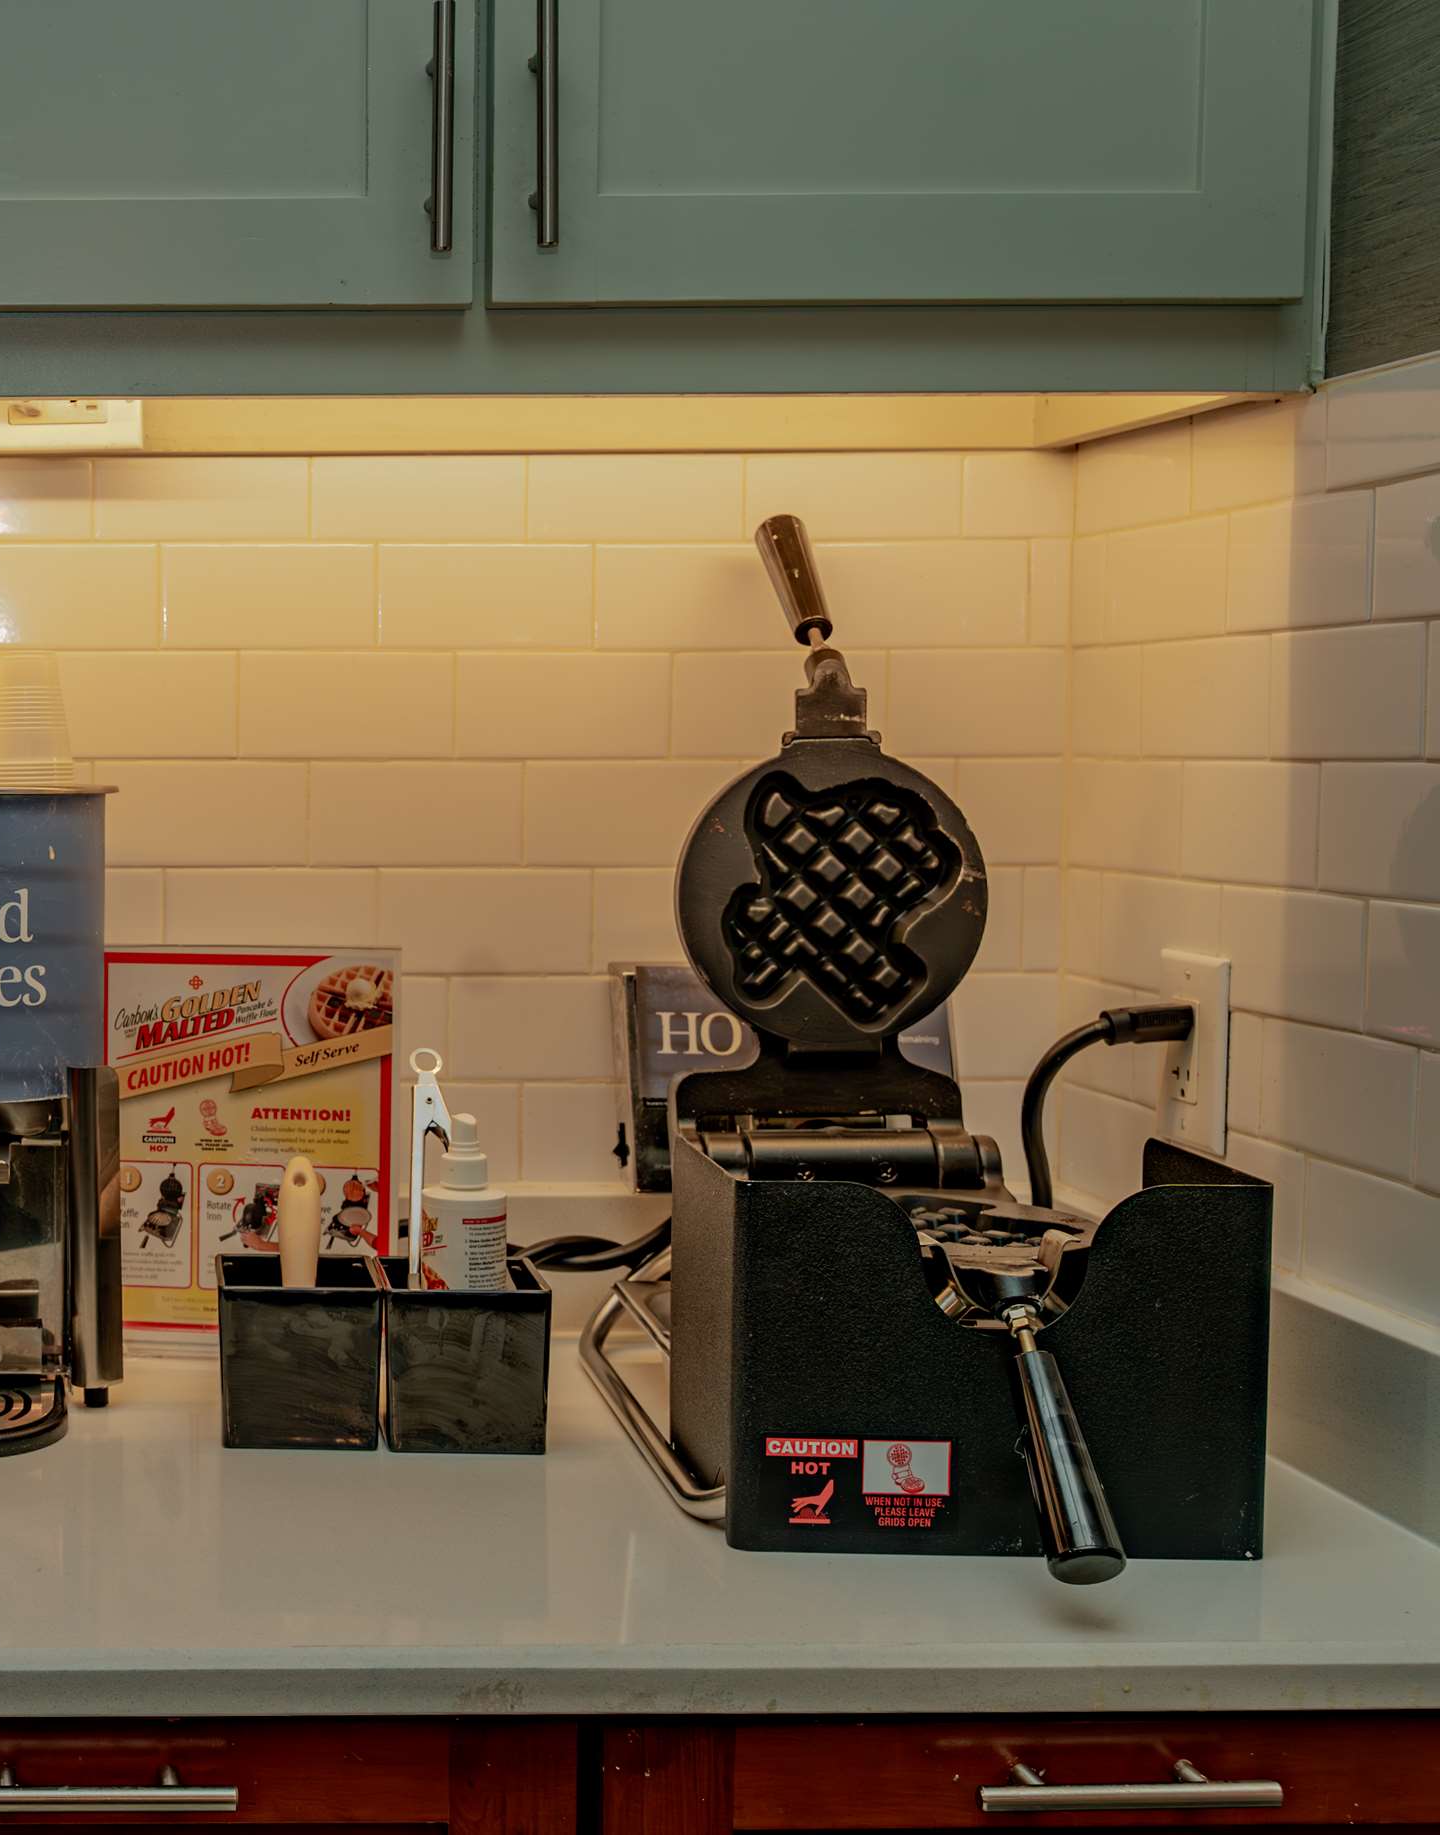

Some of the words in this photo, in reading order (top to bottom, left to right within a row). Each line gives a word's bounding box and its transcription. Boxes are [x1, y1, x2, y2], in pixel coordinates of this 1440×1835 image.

[114, 1003, 159, 1031] Carbon's
[160, 979, 262, 1023] GOLDEN
[236, 1002, 266, 1015] Pancake
[266, 998, 273, 1008] &
[235, 1012, 258, 1024] Waffle
[258, 1008, 278, 1020] Flour
[135, 1007, 236, 1050] MALTED
[655, 1011, 743, 1057] HO
[898, 1034, 940, 1046] emaining
[294, 1048, 321, 1067] Self
[322, 1043, 360, 1060] Serve
[127, 1053, 204, 1090] CAUTION
[208, 1042, 251, 1071] HOT!
[251, 1107, 352, 1122] ATTENTION!
[126, 1173, 133, 1185] 1
[217, 1176, 225, 1189] 2
[121, 1207, 139, 1218] affle
[206, 1200, 232, 1211] Rotate
[206, 1212, 222, 1221] Iron
[767, 1440, 855, 1456] CAUTION
[791, 1461, 831, 1476] HOT
[865, 1496, 891, 1507] WHEN
[893, 1497, 912, 1508] NOT
[913, 1497, 923, 1508] IN
[925, 1498, 945, 1509] USE,
[874, 1507, 906, 1517] PLEASE
[909, 1508, 936, 1517] LEAVE
[878, 1517, 905, 1527] GRIDS
[907, 1518, 932, 1528] OPEN
